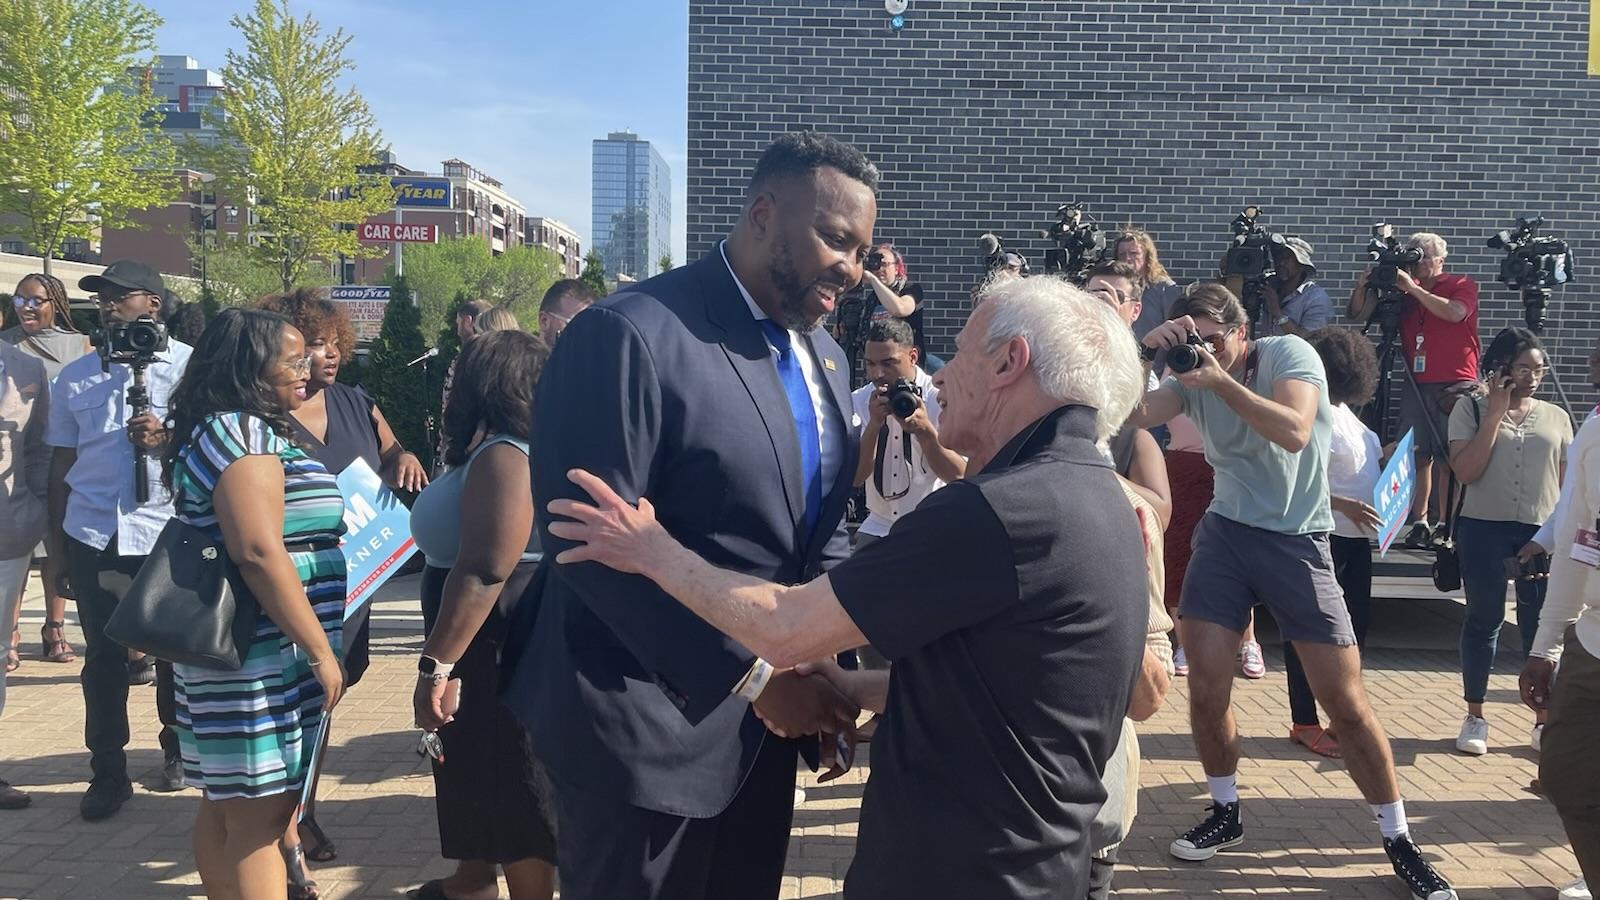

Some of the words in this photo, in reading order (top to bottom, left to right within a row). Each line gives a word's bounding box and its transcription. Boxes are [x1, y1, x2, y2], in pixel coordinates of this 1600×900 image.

[364, 224, 391, 239] CAR
[394, 225, 428, 241] CARE
[332, 288, 390, 299] GOODYEA
